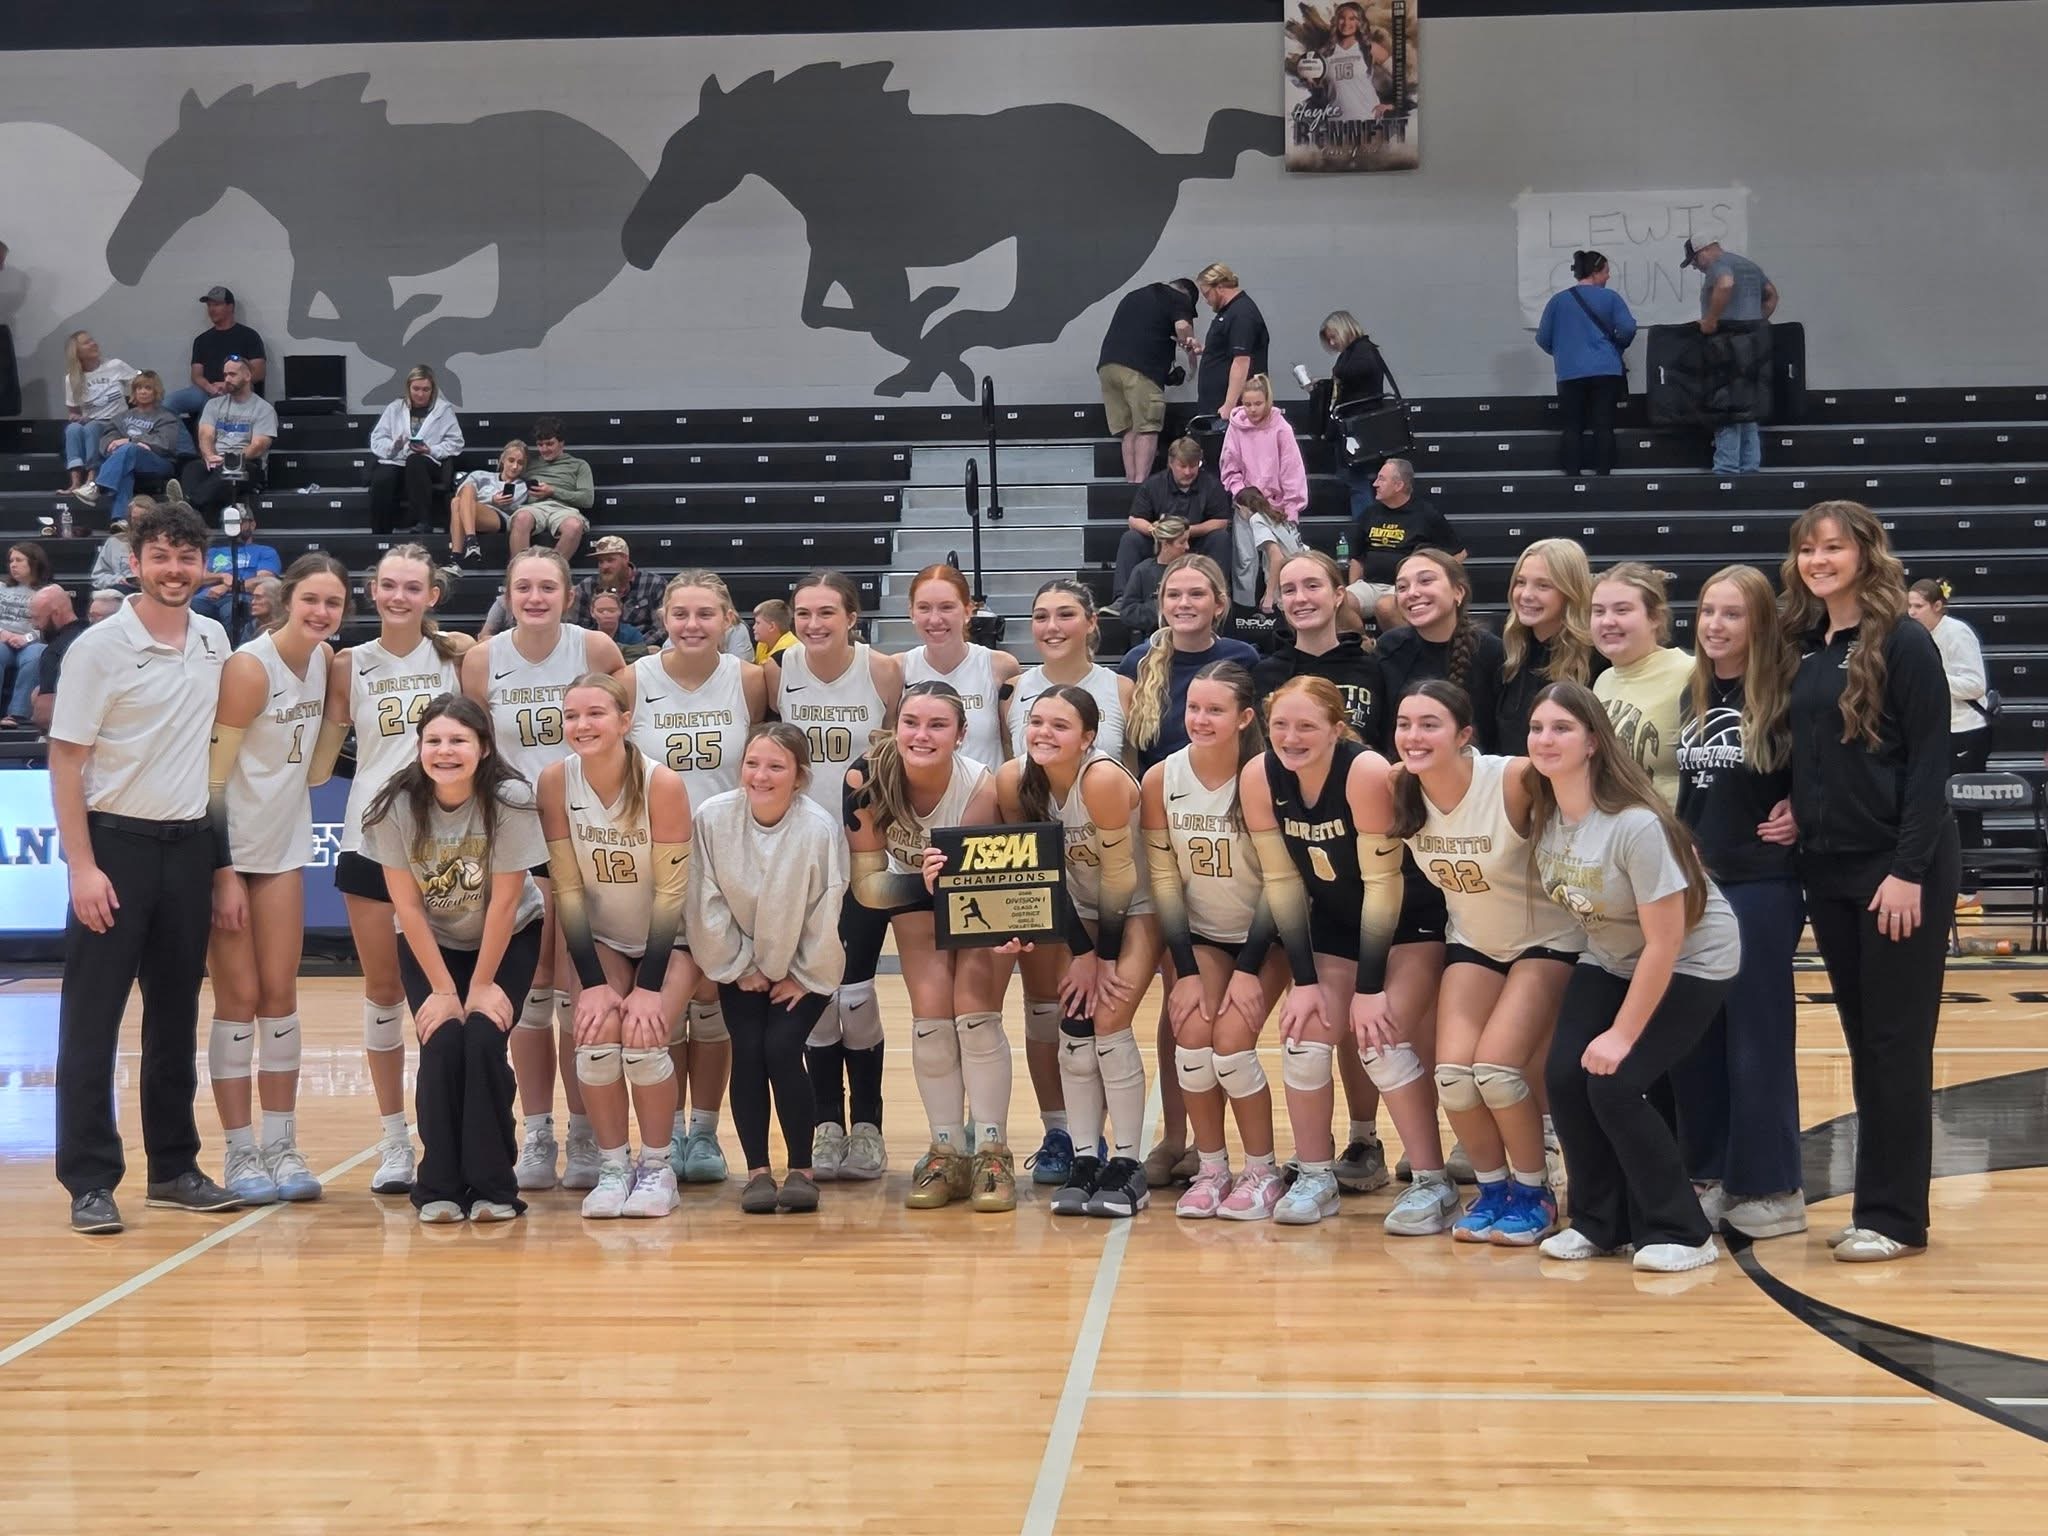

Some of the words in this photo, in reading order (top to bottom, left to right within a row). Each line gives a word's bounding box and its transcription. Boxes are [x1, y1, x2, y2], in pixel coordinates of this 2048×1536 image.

[1335, 63, 1354, 80] 16
[1549, 203, 1731, 249] LEWIS
[1236, 618, 1277, 627] ENPLAY
[368, 673, 441, 696] LORETTO
[501, 684, 566, 706] LORETT
[378, 694, 432, 737] 24
[654, 709, 733, 730] LORETTO
[791, 703, 869, 723] LORETTO
[516, 706, 564, 747] 13
[287, 724, 305, 763] 1
[665, 730, 722, 772] 25
[806, 726, 852, 763] 10
[1951, 784, 2024, 800] LORETTO
[1283, 817, 1346, 842] LORETTO
[1415, 833, 1492, 855] LORETTO
[592, 848, 638, 884] 12
[1188, 837, 1233, 878] 21
[952, 872, 1047, 887] CHAMPIONS
[1429, 858, 1491, 894] 32
[1005, 896, 1041, 905] DIVISION
[1011, 910, 1040, 918] DISTRICT
